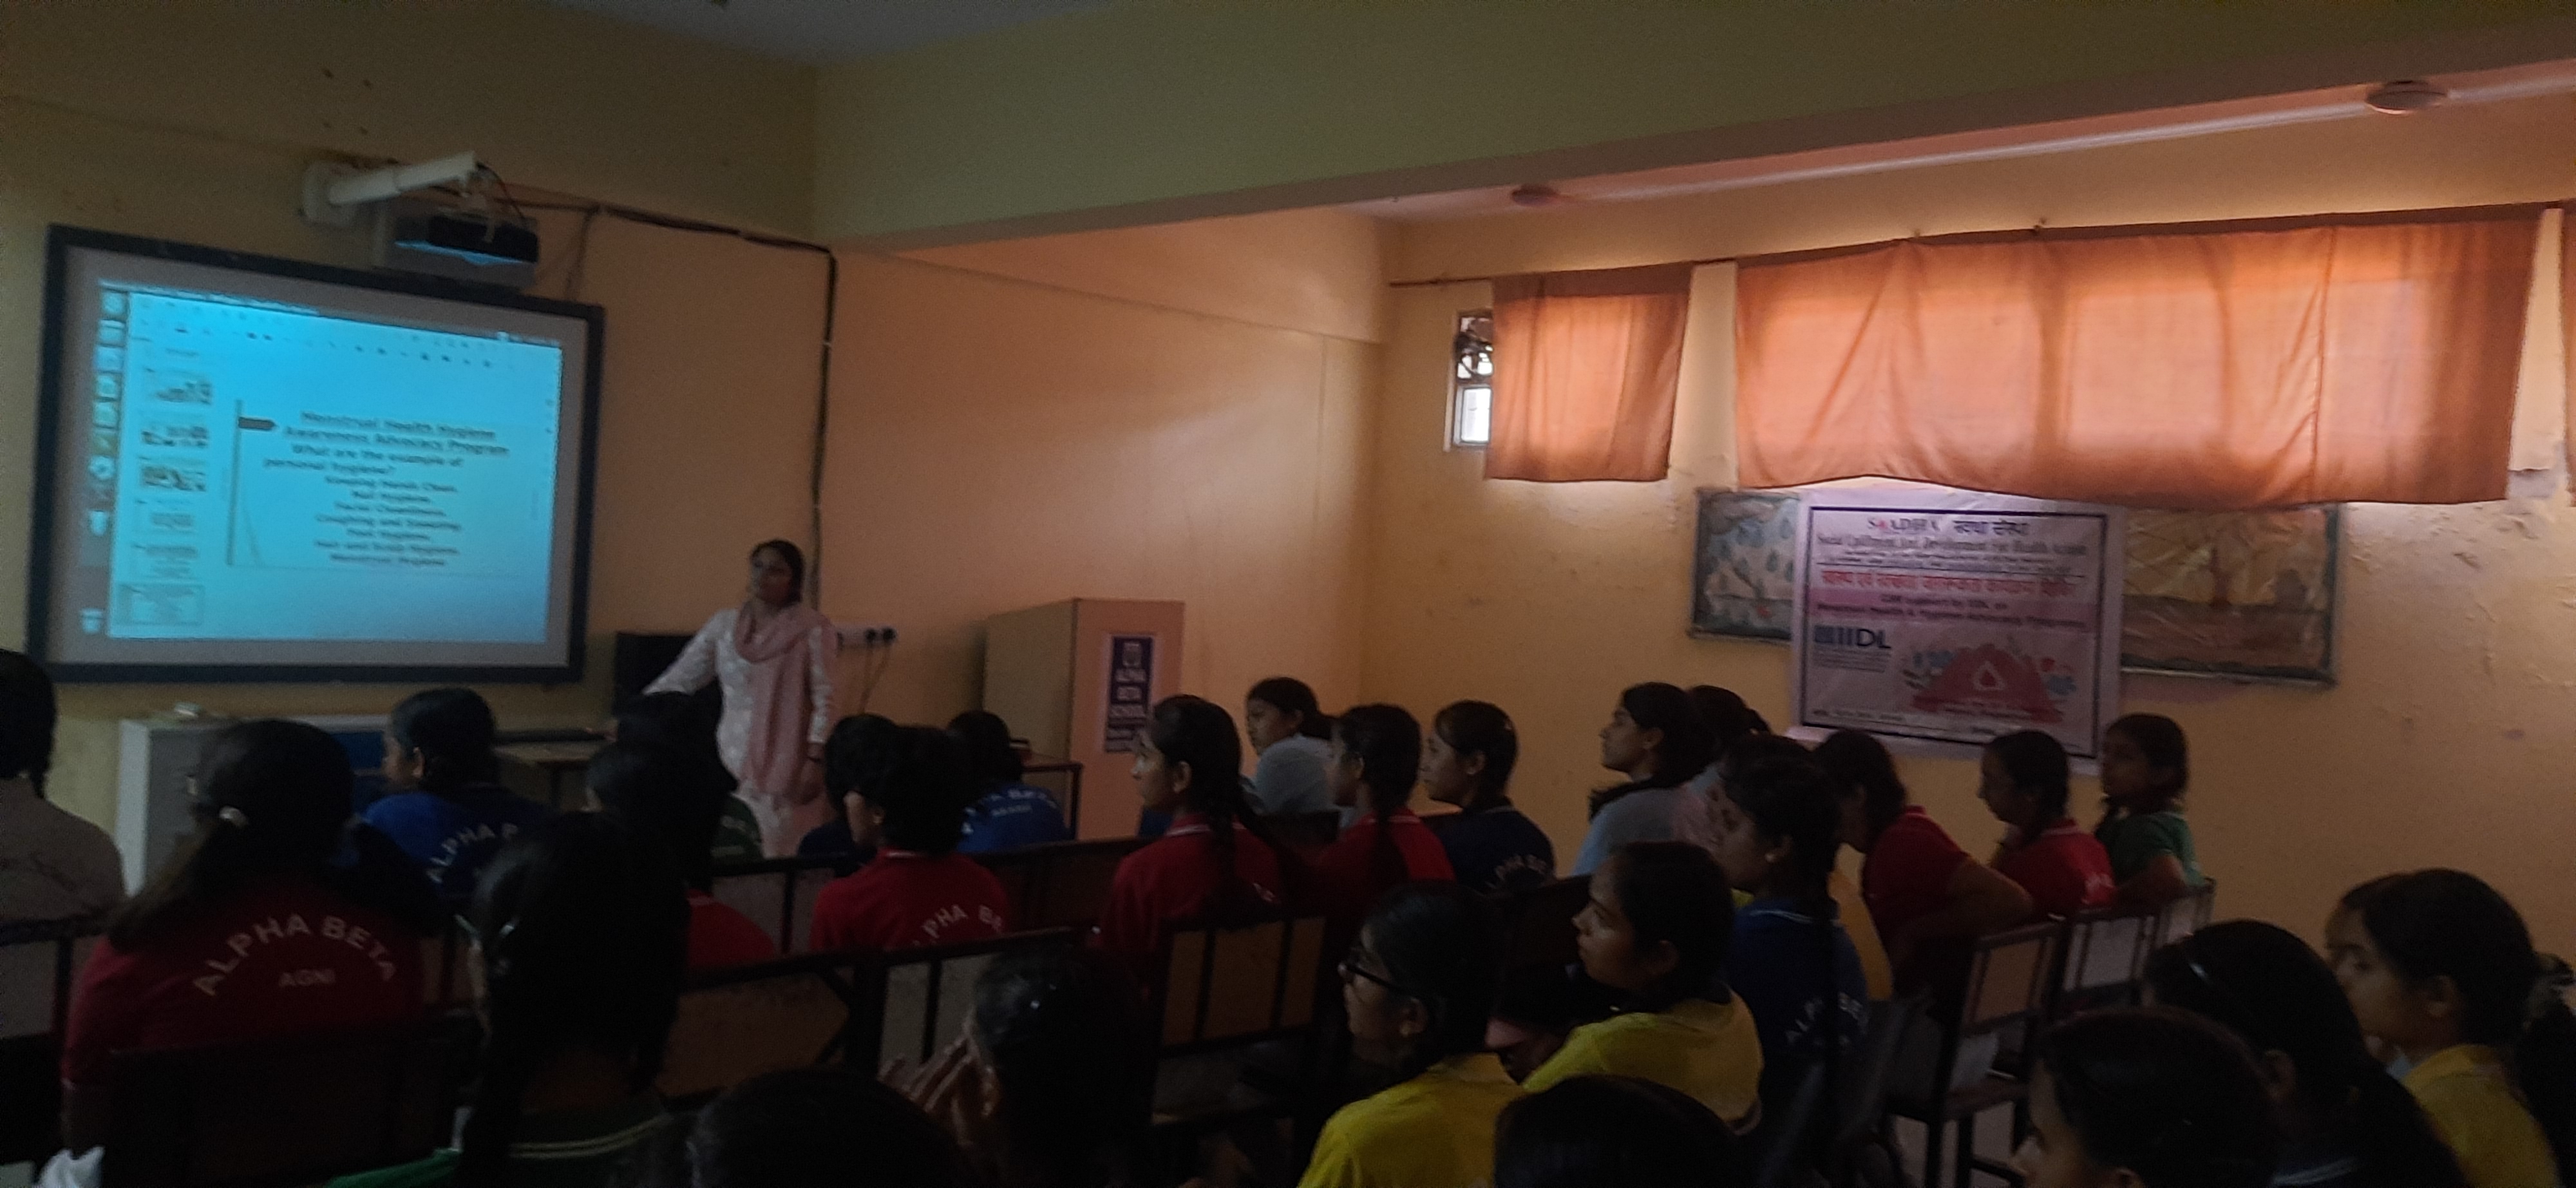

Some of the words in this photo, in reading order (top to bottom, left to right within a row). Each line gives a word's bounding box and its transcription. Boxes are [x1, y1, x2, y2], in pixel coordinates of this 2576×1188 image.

[292, 444, 329, 455] What
[361, 449, 383, 459] the
[425, 823, 497, 885] ALPHA
[193, 913, 311, 997] ALPHA
[319, 915, 397, 982] BETA
[278, 968, 336, 988] AGNI
